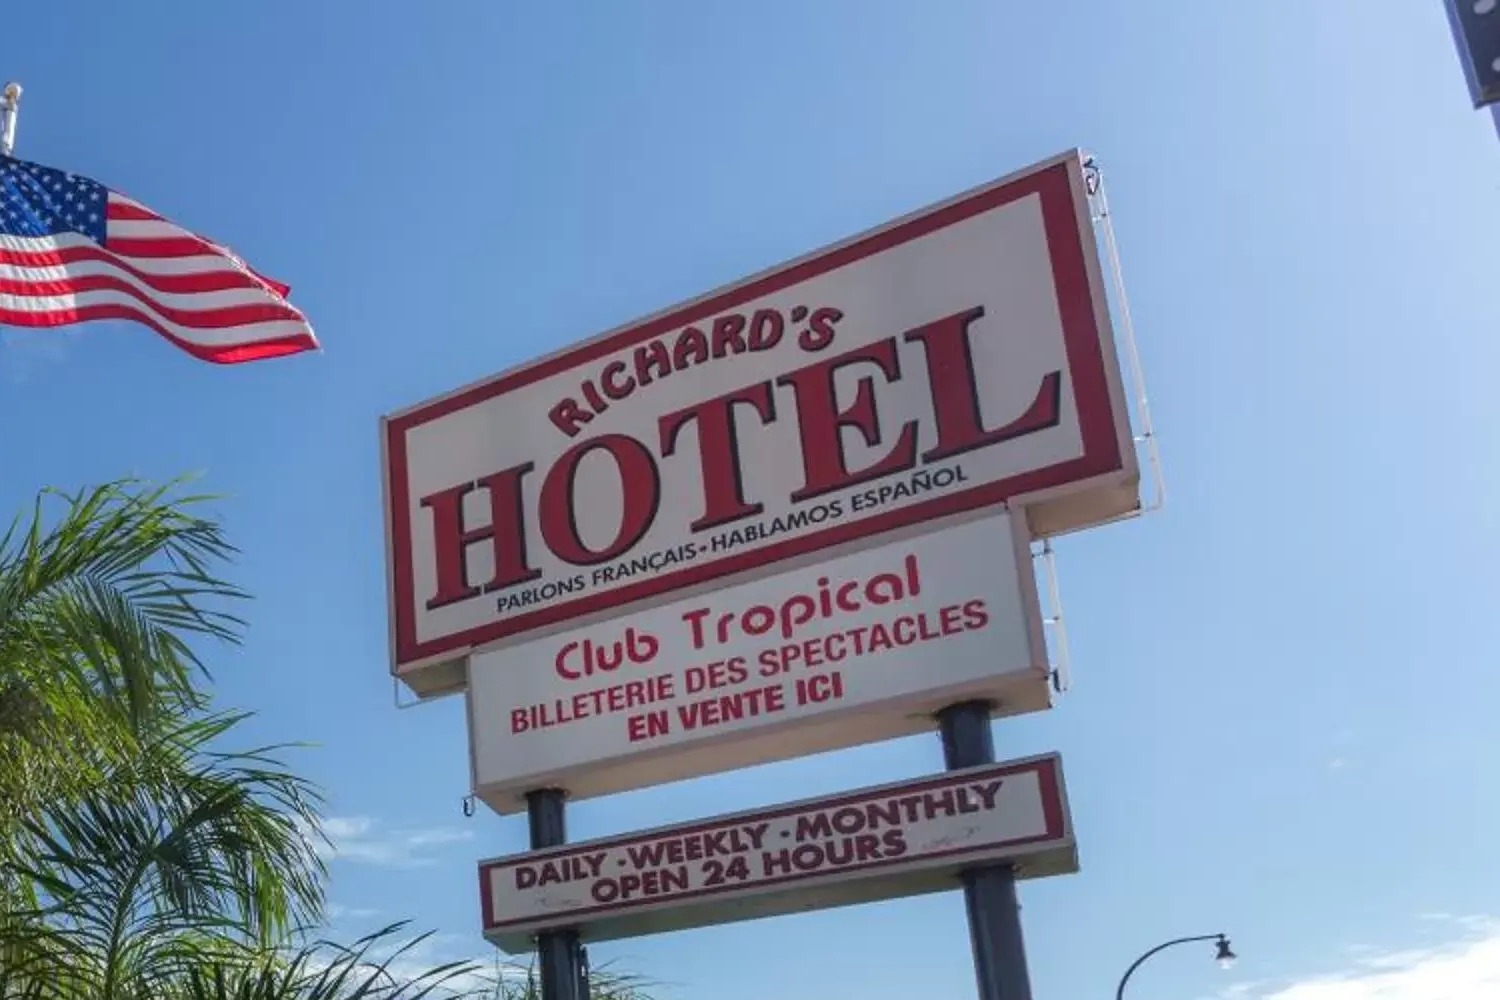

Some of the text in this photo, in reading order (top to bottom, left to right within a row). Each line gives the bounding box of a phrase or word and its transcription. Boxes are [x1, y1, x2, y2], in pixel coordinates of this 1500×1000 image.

[548, 305, 844, 437] RICHARD'S
[420, 306, 1062, 610] HOTEL
[496, 574, 586, 613] PARLONS
[851, 464, 969, 512] ESPAÑOL
[510, 599, 990, 735] BILLETERIE DES SPECTACLES
[555, 553, 921, 681] Club Tropical
[627, 671, 844, 743] EN VENTE ICI
[514, 852, 608, 891] DAILY
[591, 828, 908, 903] OPEN 24 HOURS
